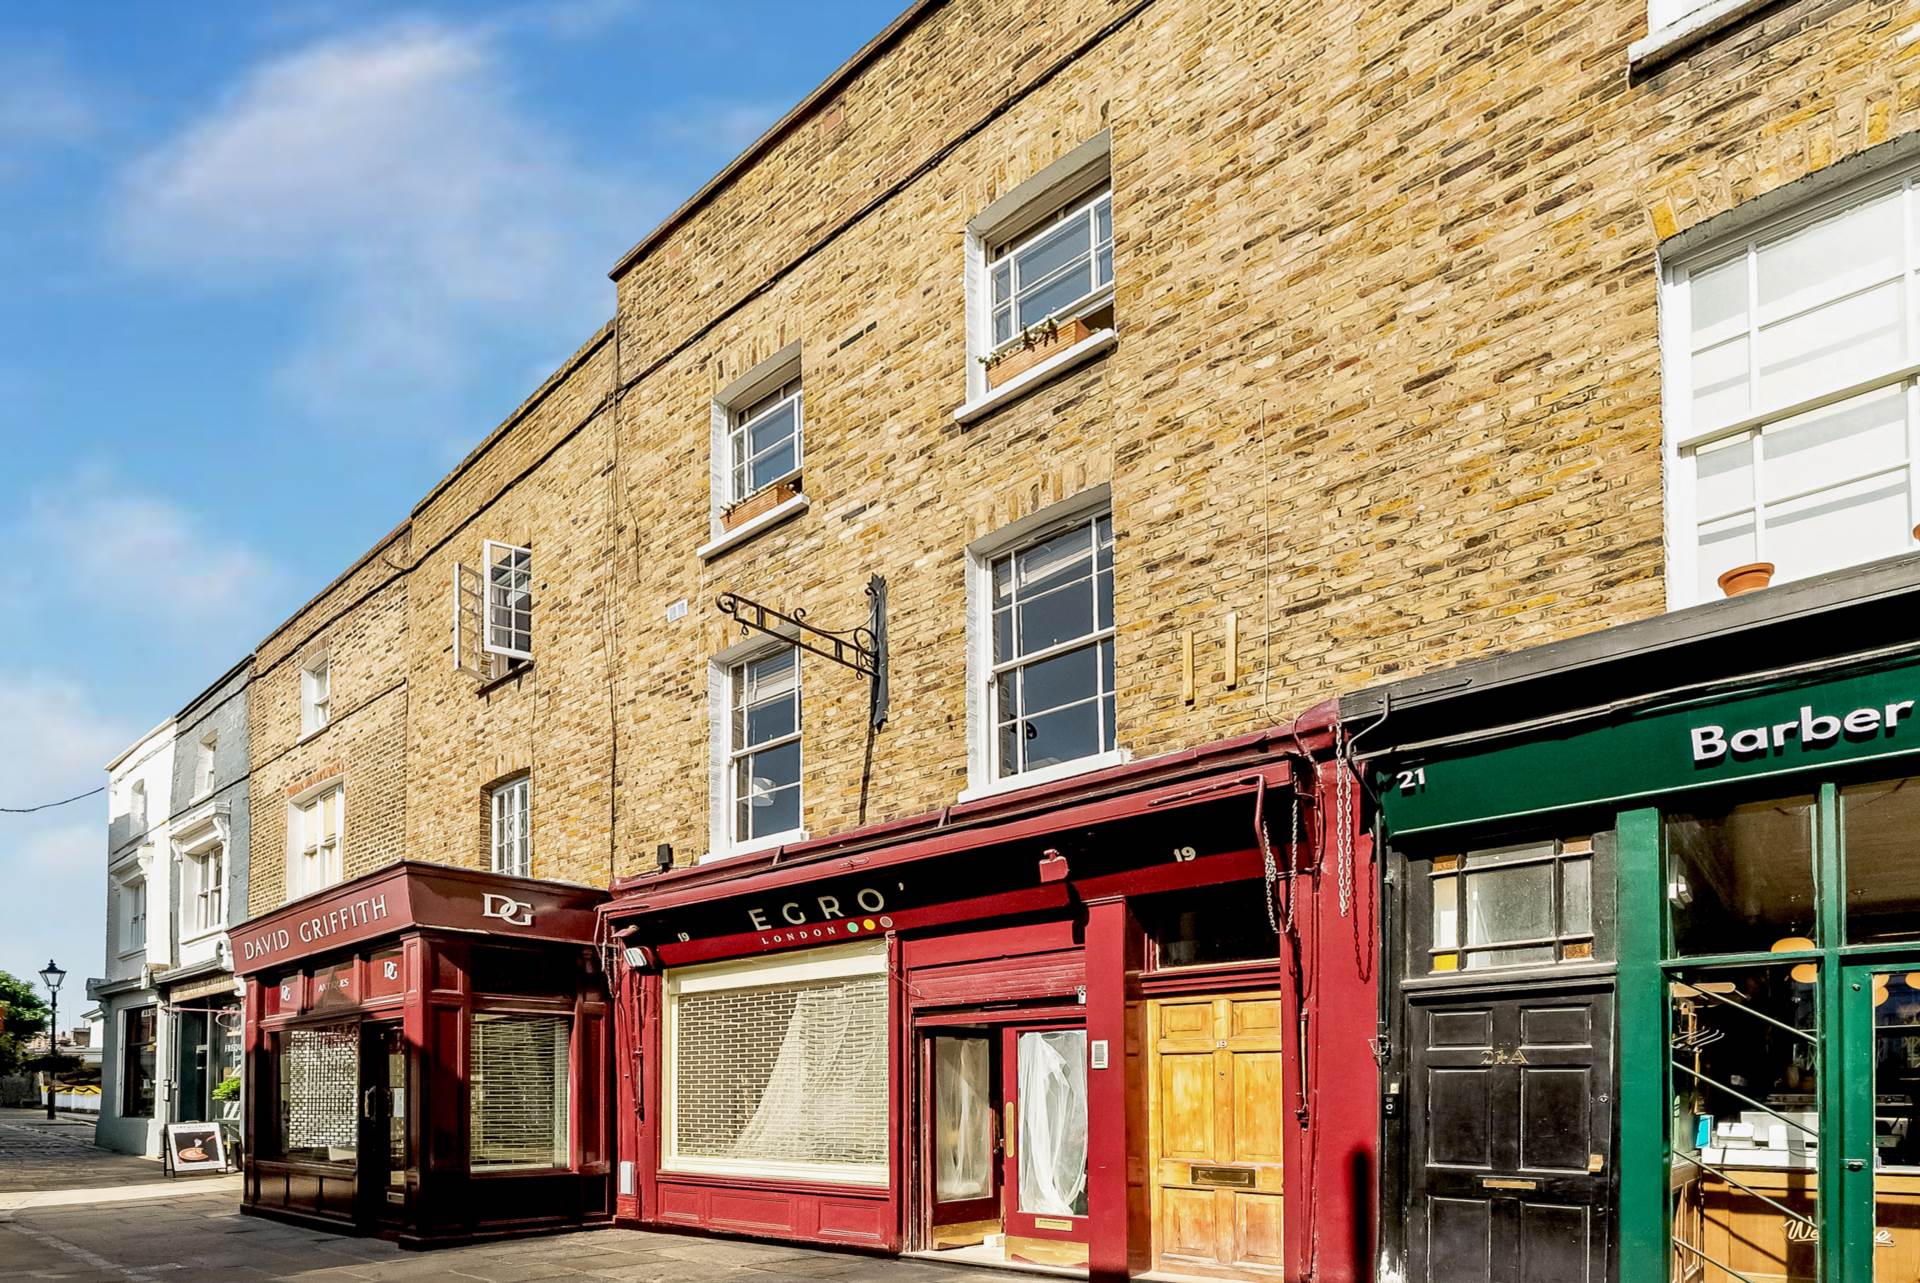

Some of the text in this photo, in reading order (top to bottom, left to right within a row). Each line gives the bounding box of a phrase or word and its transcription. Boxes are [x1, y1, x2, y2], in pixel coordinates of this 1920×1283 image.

[1690, 700, 1916, 761] Barber
[1395, 767, 1426, 789] 21
[1173, 846, 1197, 863] 19
[481, 892, 534, 926] DG
[244, 894, 388, 961] DAVID GRIFFITH
[677, 931, 690, 942] 19
[761, 926, 836, 945] LONDON
